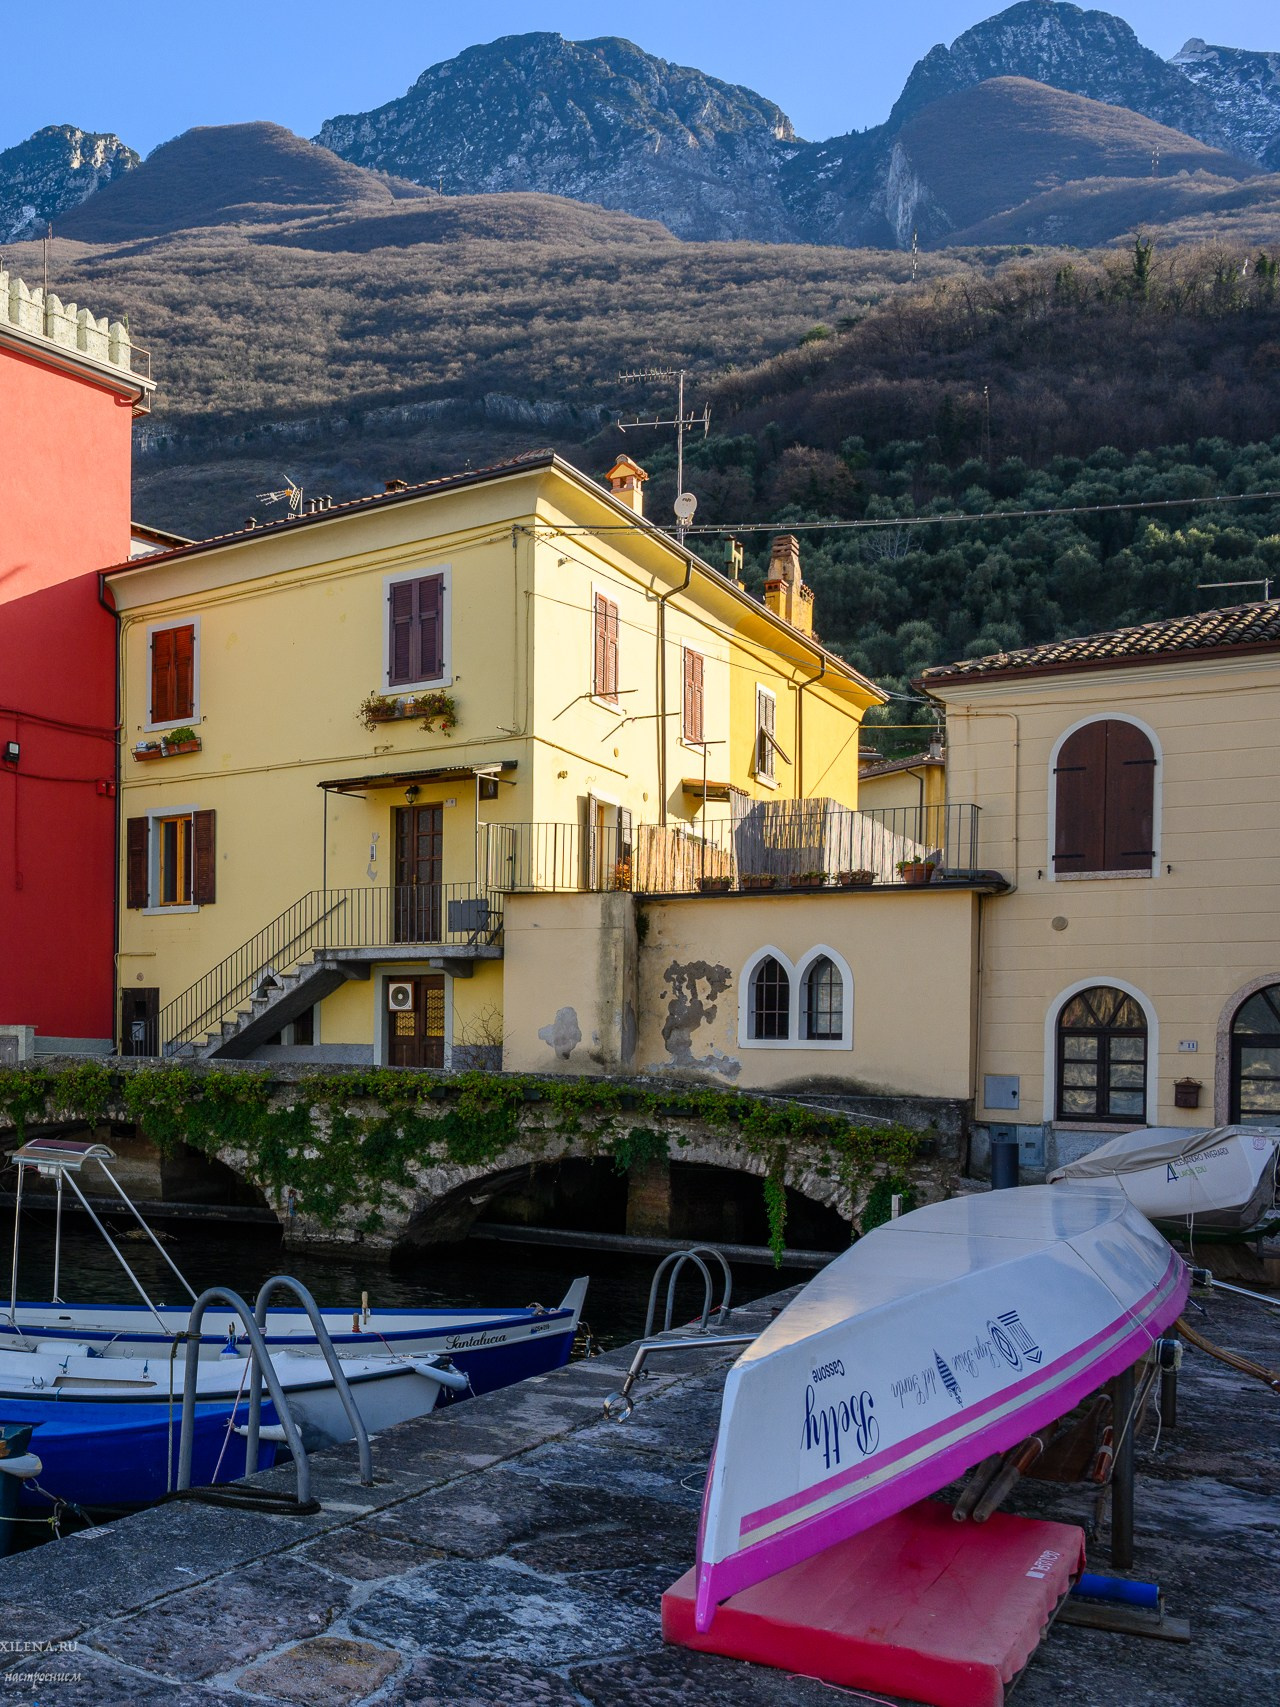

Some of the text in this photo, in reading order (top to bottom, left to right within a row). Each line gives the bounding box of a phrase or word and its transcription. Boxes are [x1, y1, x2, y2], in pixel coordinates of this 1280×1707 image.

[445, 1331, 507, 1350] Santalucia
[812, 1359, 845, 1383] Cassone
[922, 1367, 936, 1401] del
[890, 1374, 926, 1409] Garda
[800, 1385, 880, 1469] Betty
